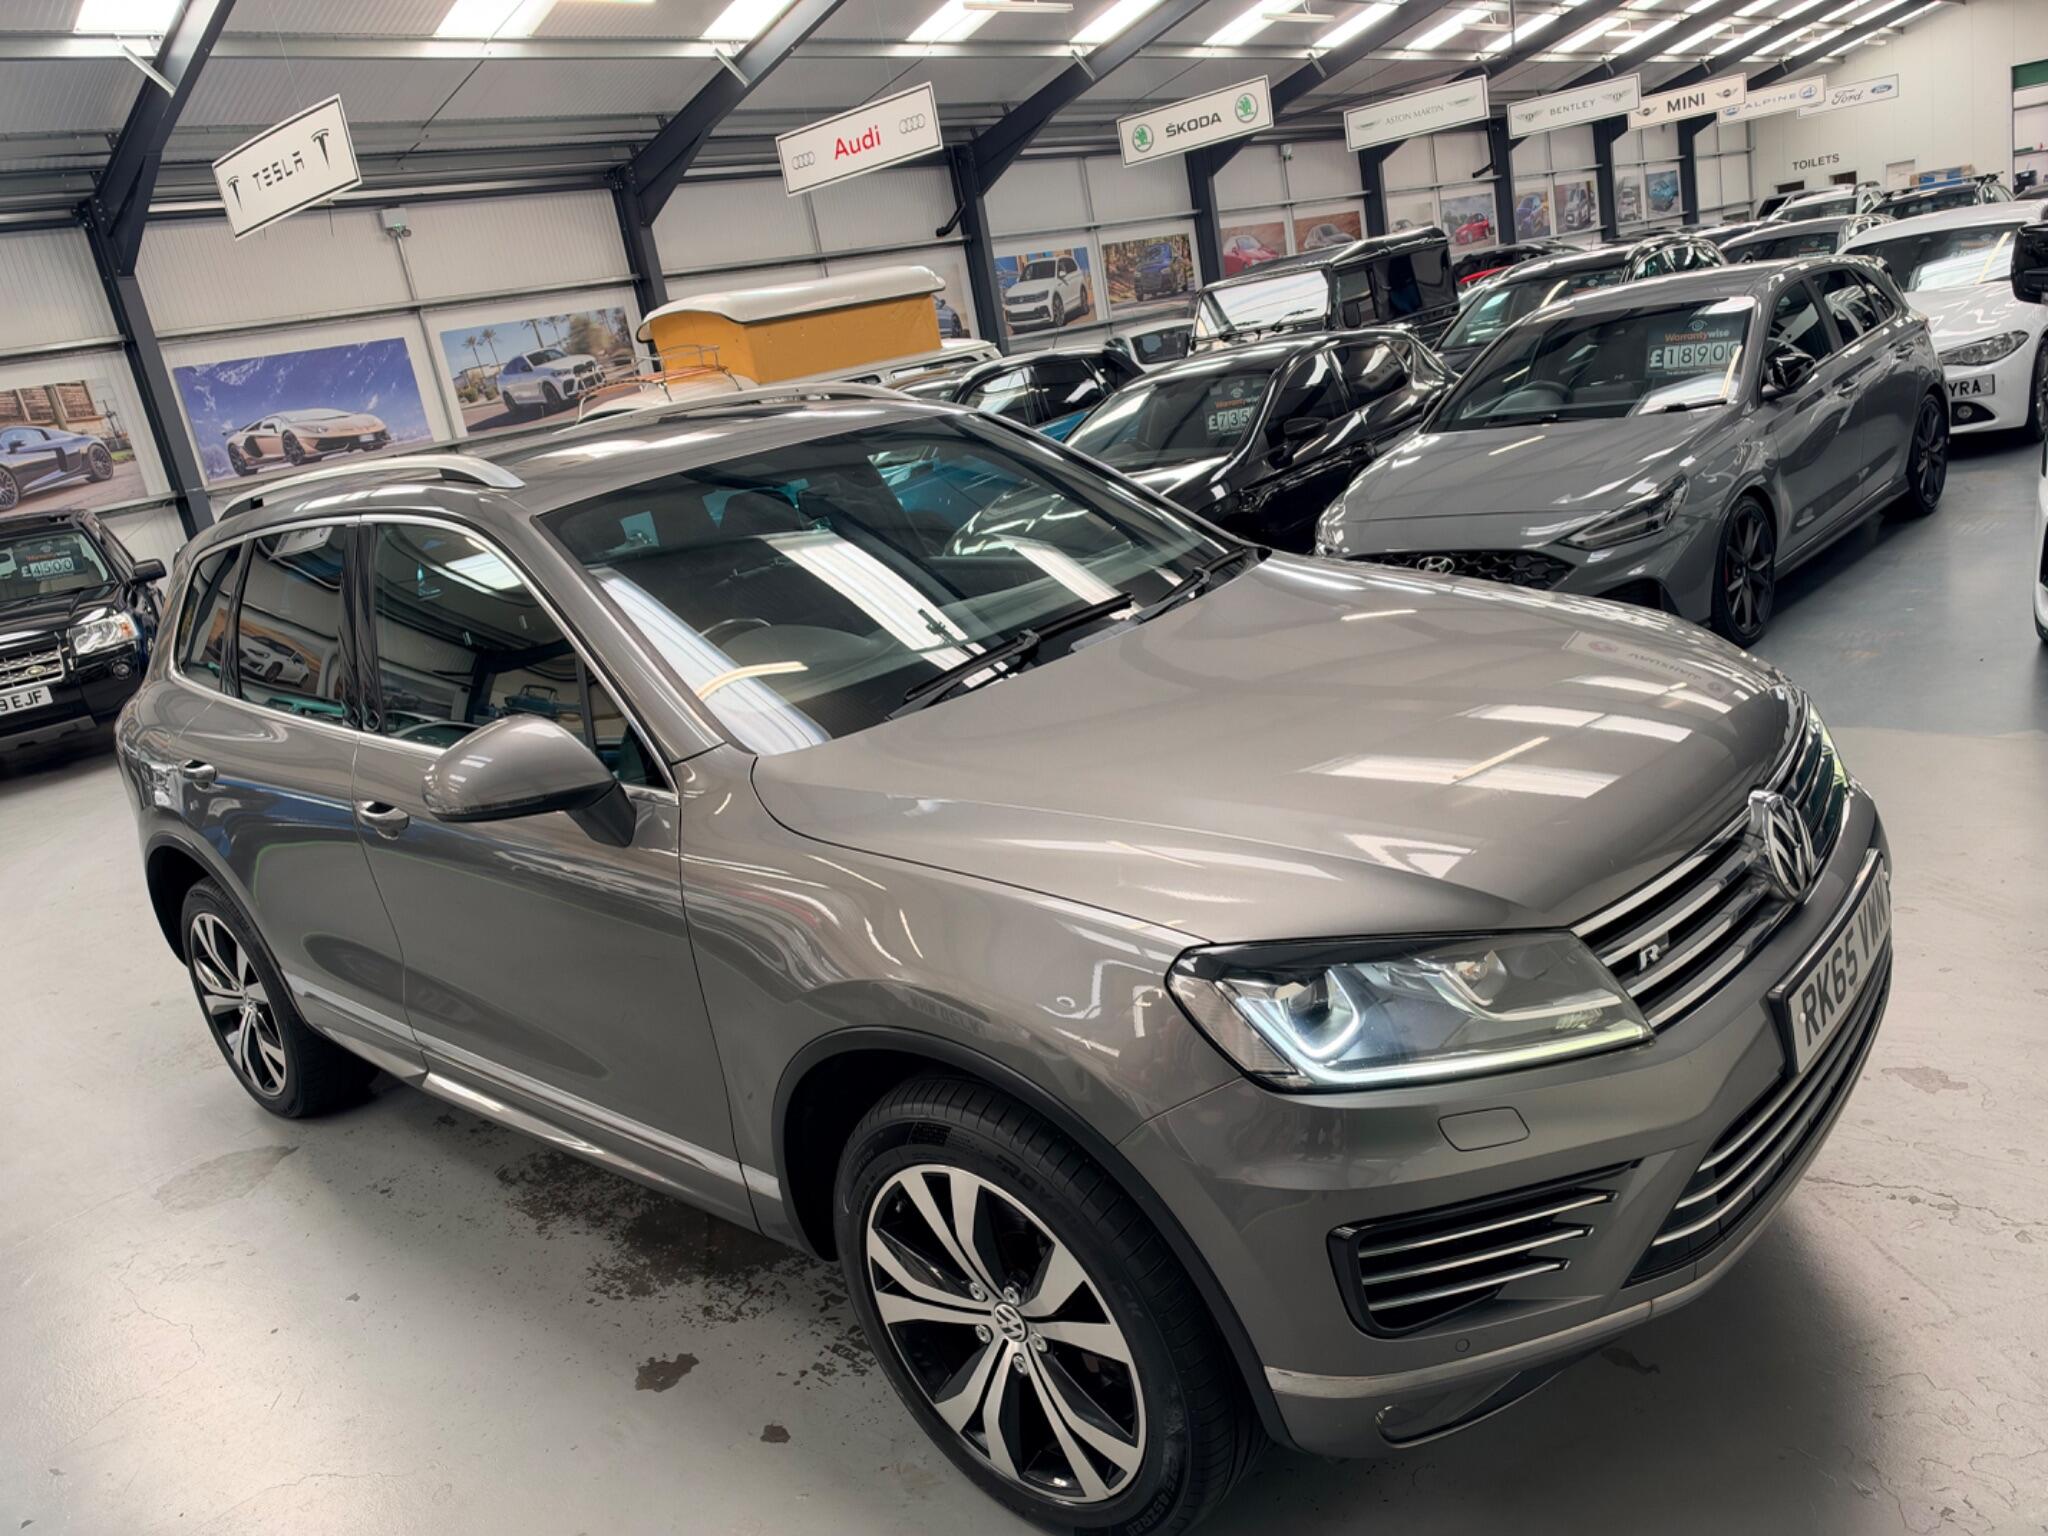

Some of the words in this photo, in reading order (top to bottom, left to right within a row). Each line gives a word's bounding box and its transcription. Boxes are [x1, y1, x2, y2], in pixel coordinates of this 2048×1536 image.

[1667, 92, 1706, 113] MINI
[1745, 92, 1797, 109] ALPINE
[1831, 88, 1864, 105] Ford
[1384, 111, 1412, 126] ASTON
[1413, 104, 1445, 120] MARTIN
[1549, 98, 1596, 116] BENTLEY
[1165, 112, 1222, 138] ŠKODA
[833, 124, 882, 161] Audi
[252, 150, 305, 191] TESLA
[1792, 153, 1840, 171] TOILETS
[1948, 379, 1982, 398] YRA
[11, 690, 42, 709] EJF
[1800, 925, 1858, 1047] RK65
